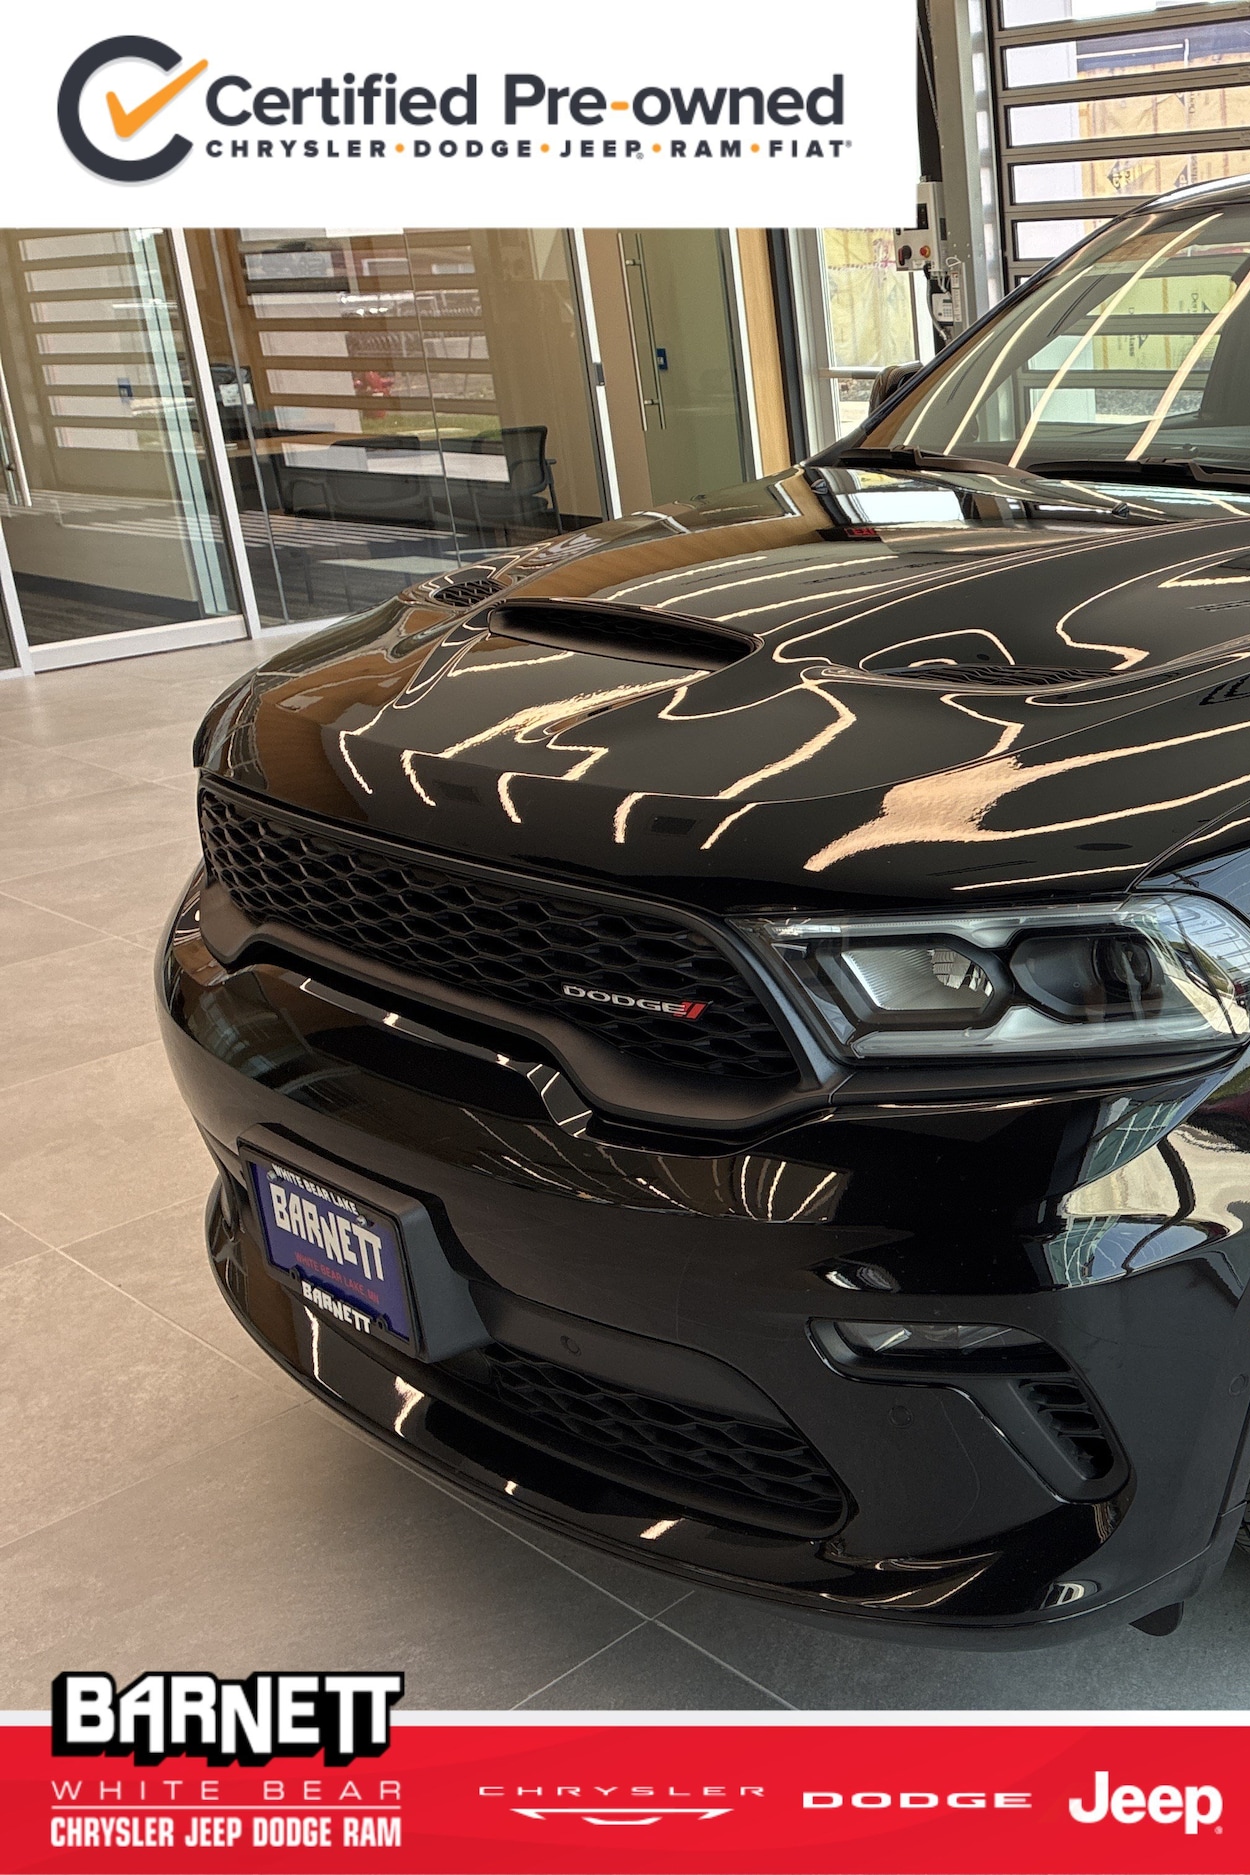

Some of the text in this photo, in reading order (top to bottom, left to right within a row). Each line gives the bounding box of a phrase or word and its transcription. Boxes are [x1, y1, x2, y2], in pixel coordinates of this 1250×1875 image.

[562, 984, 687, 1016] DODGE
[271, 1162, 360, 1217] WHITE BEAR LAKE
[269, 1182, 383, 1281] BARNETT
[295, 1250, 320, 1273] WHITE
[320, 1265, 343, 1284] BEAR
[301, 1280, 371, 1334] BARNETT
